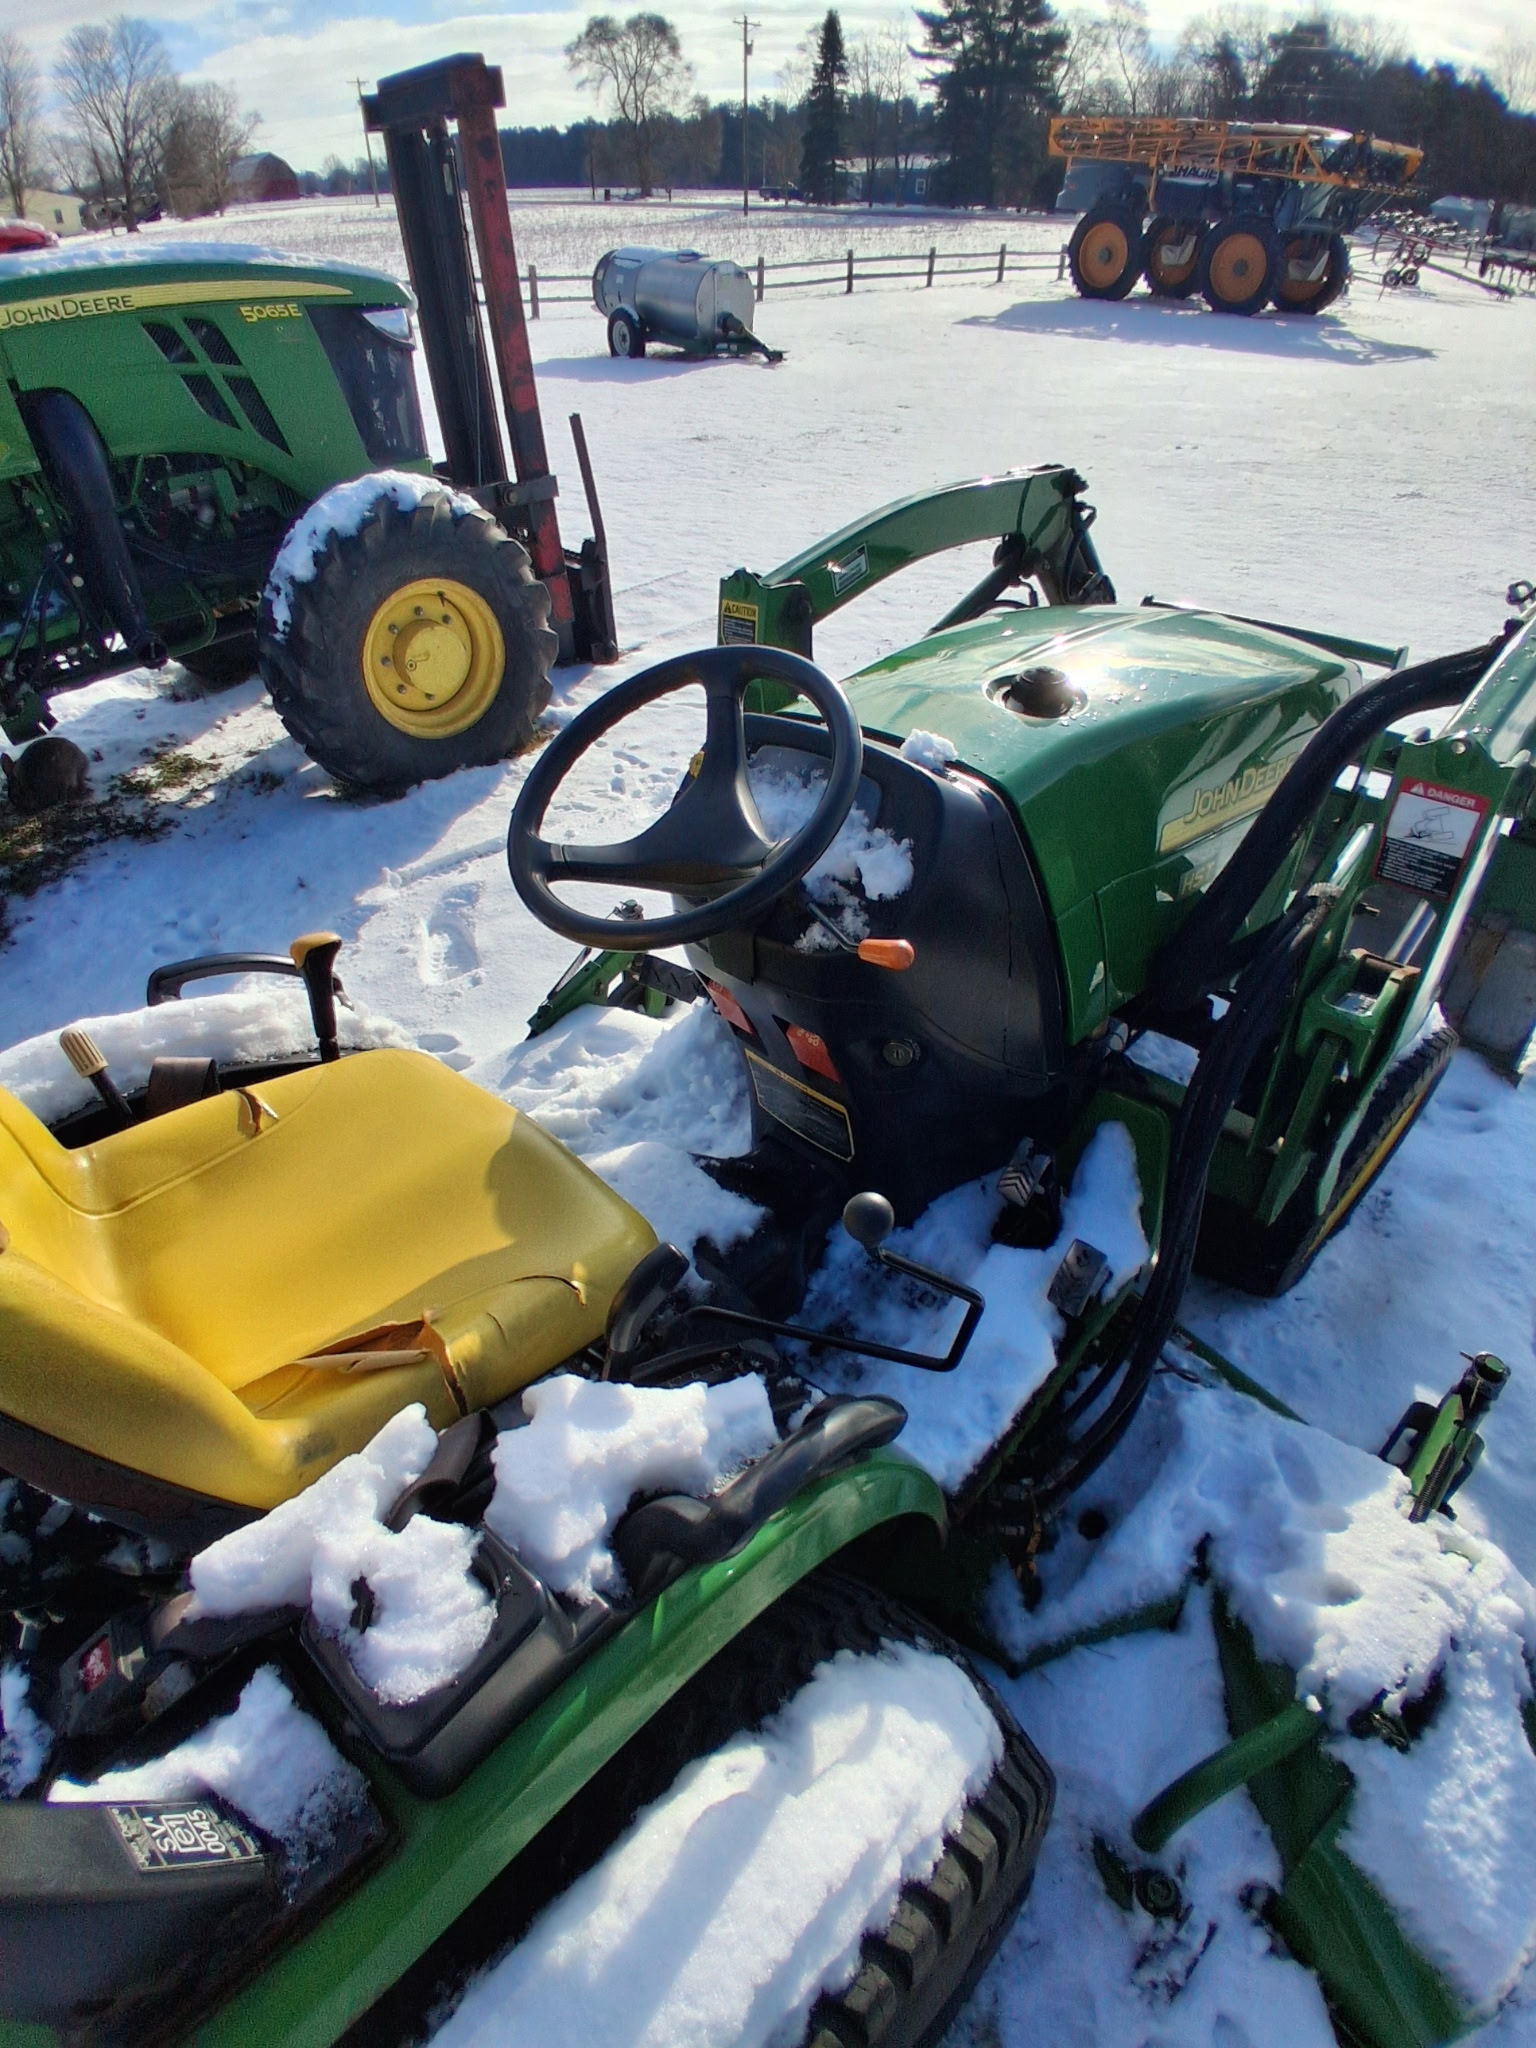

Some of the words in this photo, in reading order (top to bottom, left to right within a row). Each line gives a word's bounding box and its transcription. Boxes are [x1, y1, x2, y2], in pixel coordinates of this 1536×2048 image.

[0, 306, 60, 327] JOHN
[61, 295, 135, 316] DEERE
[240, 303, 302, 323] 5065E
[1183, 778, 1241, 823] JOHN
[1427, 787, 1477, 808] DANGER
[188, 1809, 226, 1853] 0045
